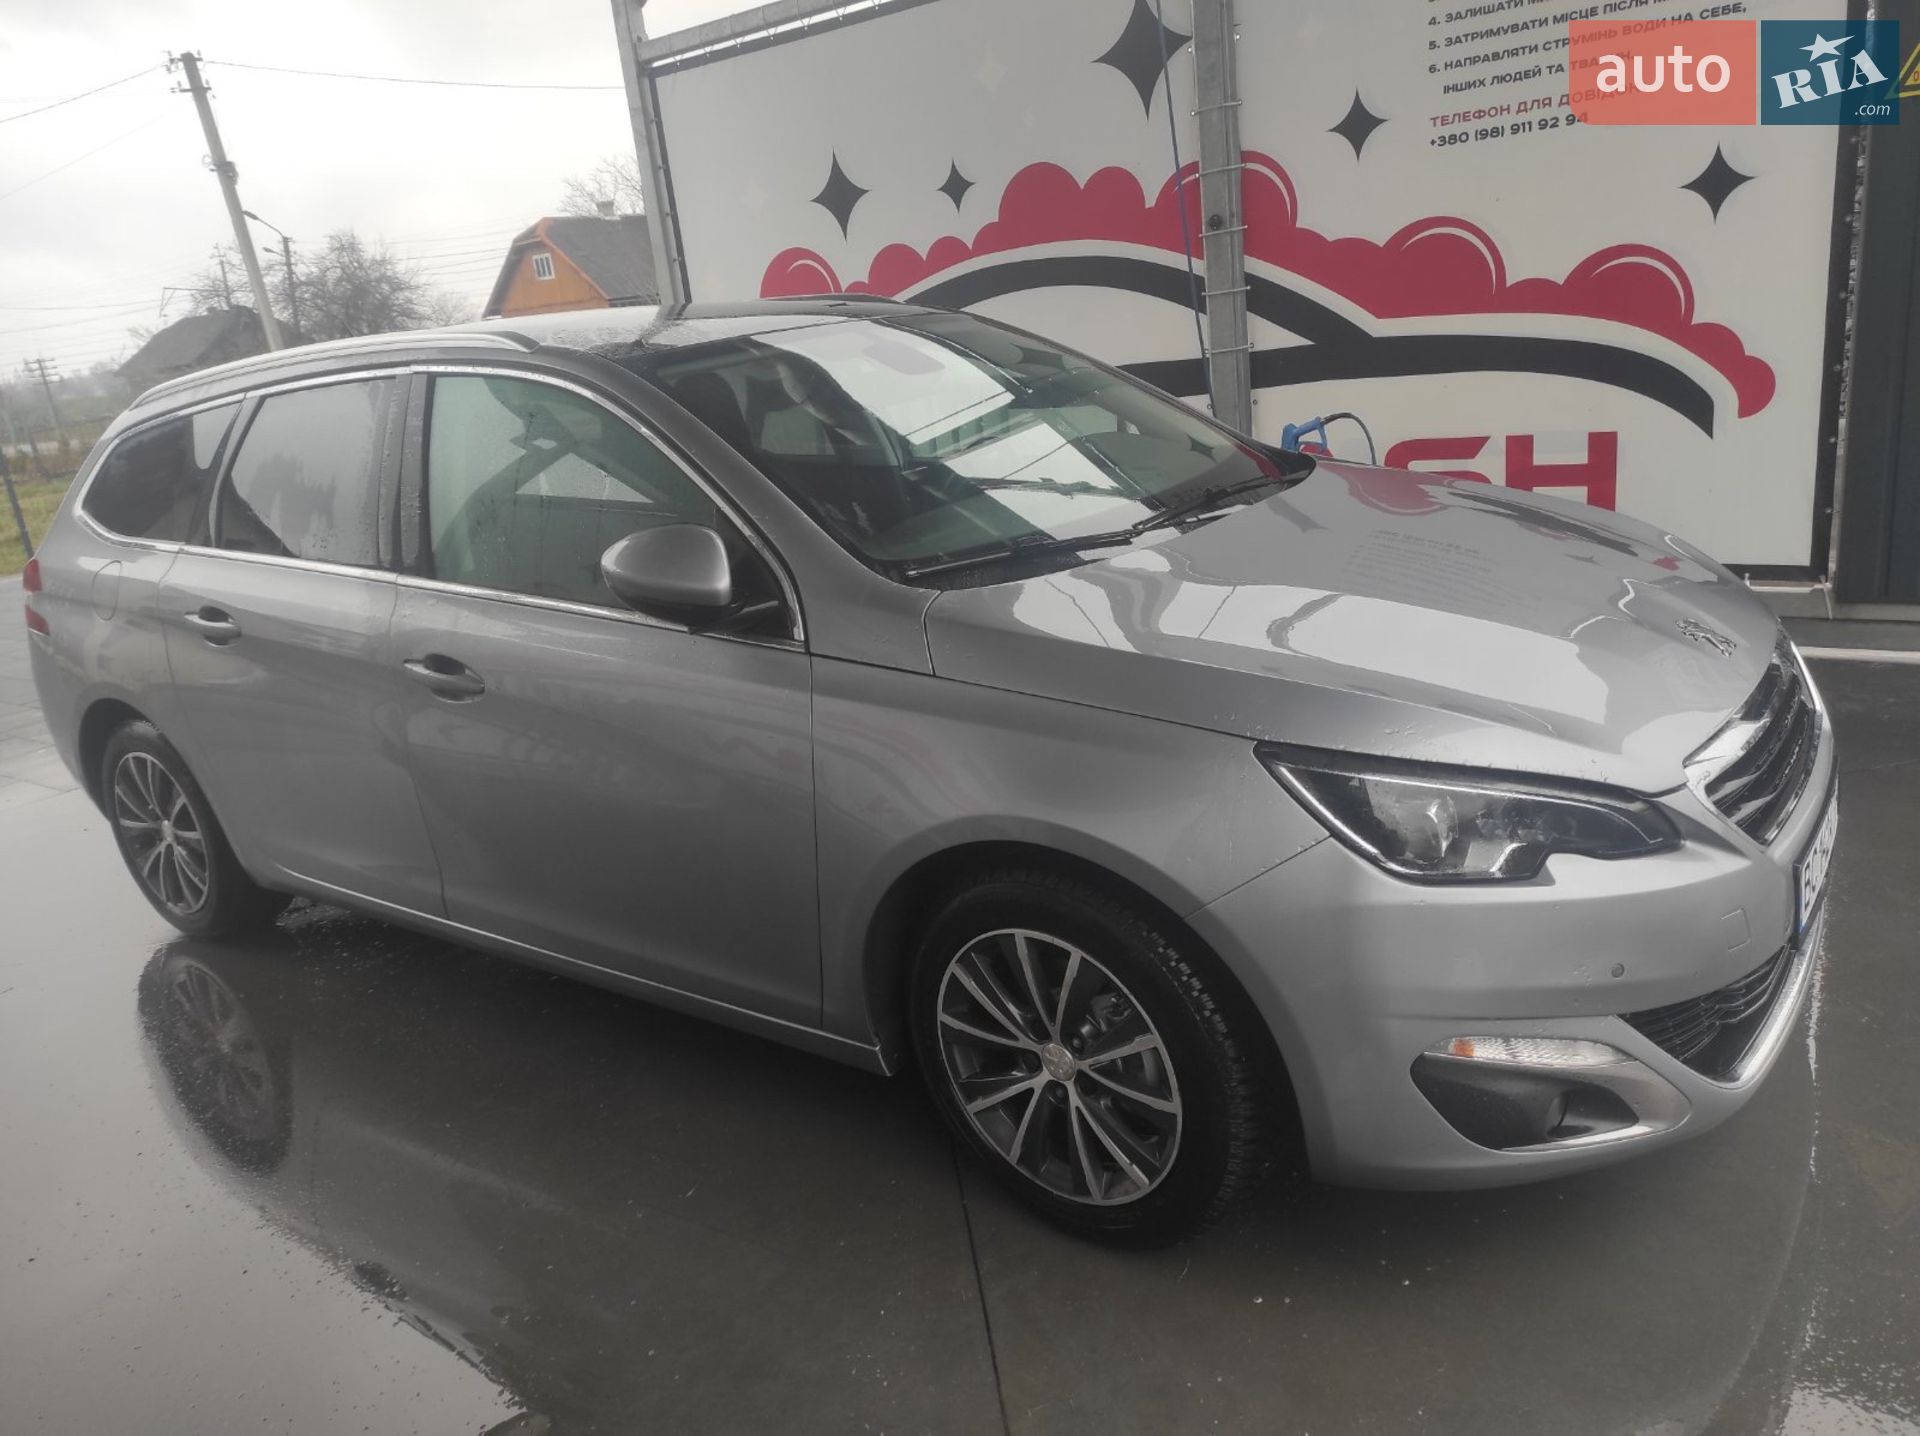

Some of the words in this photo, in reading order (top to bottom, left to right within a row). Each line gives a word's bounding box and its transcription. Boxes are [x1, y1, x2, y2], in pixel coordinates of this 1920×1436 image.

[1428, 16, 1441, 26] 4.
[1444, 0, 1524, 23] ЗАЛИШАТИ
[1428, 40, 1441, 50] 5.
[1444, 16, 1549, 47] ЗАТРИМУВАТИ
[1552, 6, 1599, 25] МІСЦЕ
[1428, 64, 1441, 74] 6.
[1444, 44, 1539, 71] НАПРАВЛЯТИ
[1542, 28, 1618, 52] СТРУМІНЬ
[1622, 18, 1666, 37] ВОДИ
[1671, 12, 1694, 27] НА
[1699, 2, 1747, 20] СЕБЕ,
[1443, 77, 1487, 95] ІНШИХ
[1490, 65, 1542, 86] ЛЮДЕЙ
[1546, 63, 1566, 75] ТА
[1430, 104, 1511, 127] ТЕЛЕФОН
[1516, 97, 1552, 115] ДЛЯ
[1430, 131, 1469, 147] +380
[1475, 125, 1505, 142] (98)
[1510, 121, 1533, 135] 911
[1538, 116, 1560, 131] 92
[1565, 112, 1588, 127] 94
[1300, 431, 1618, 511] SH
